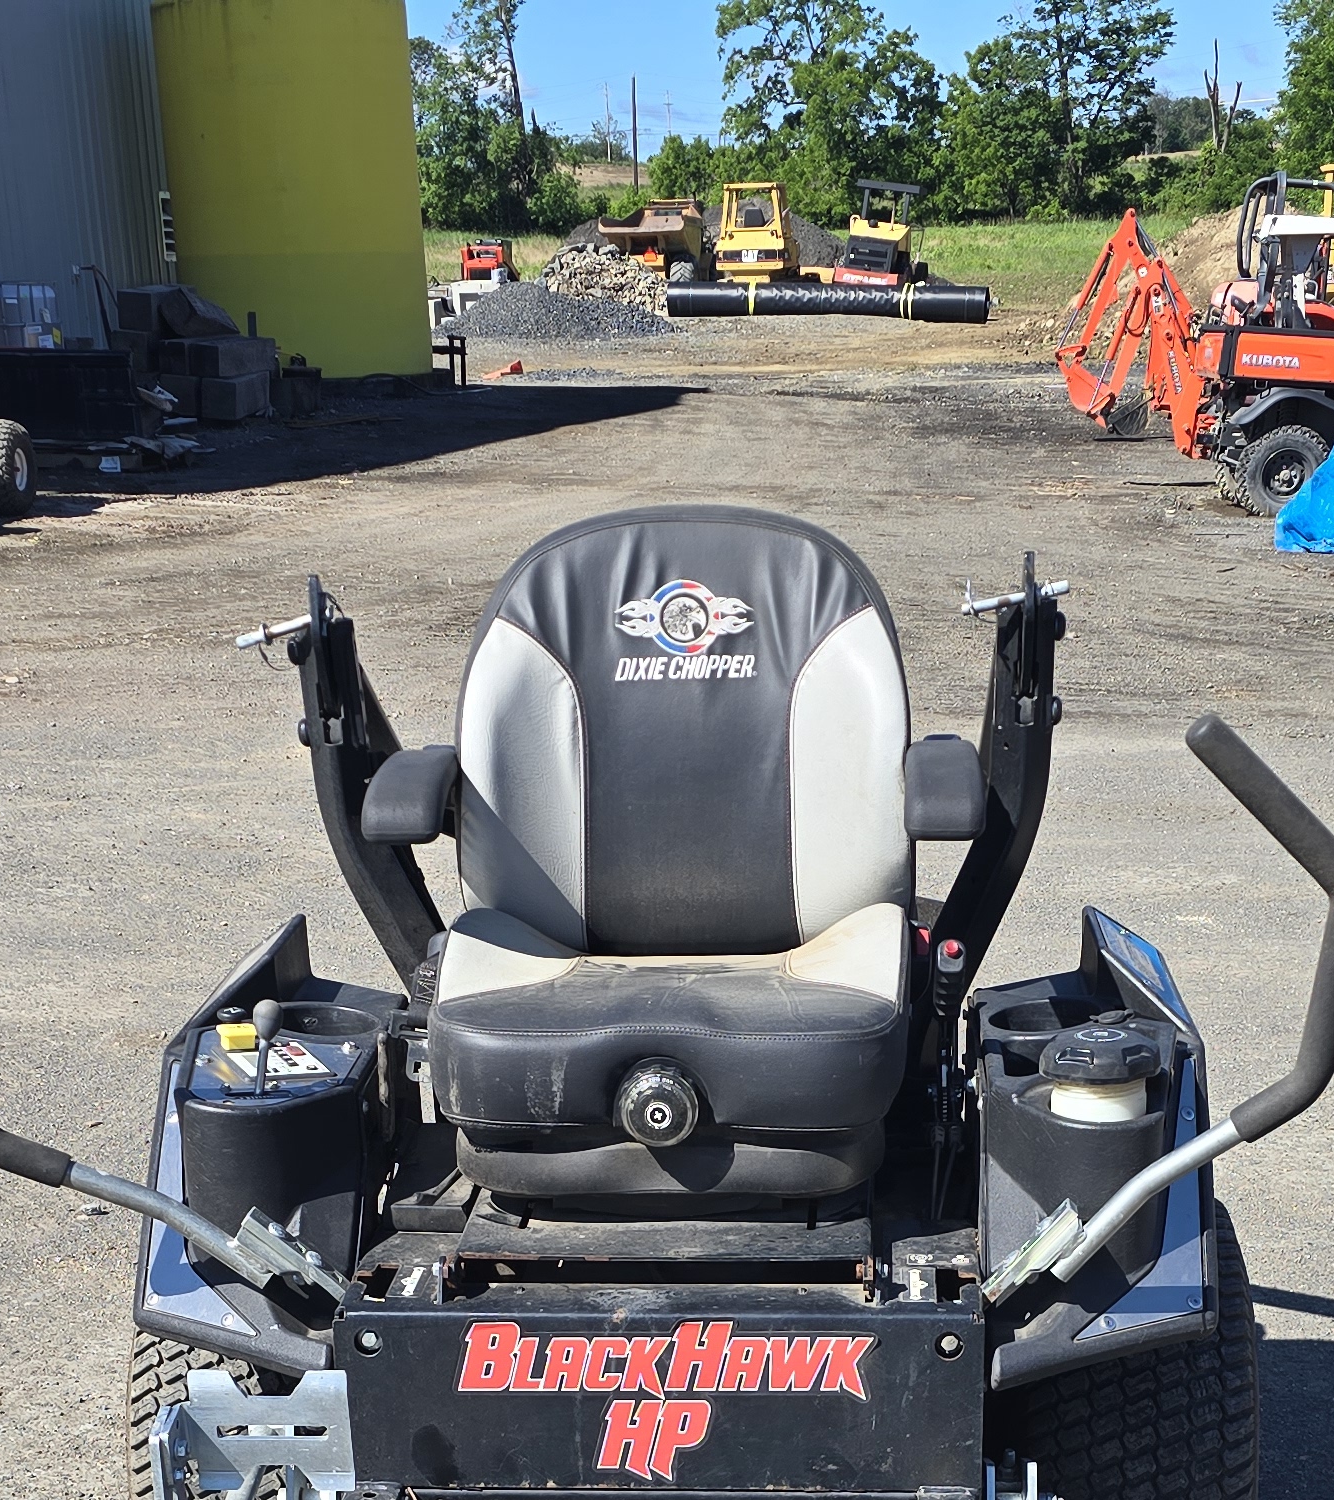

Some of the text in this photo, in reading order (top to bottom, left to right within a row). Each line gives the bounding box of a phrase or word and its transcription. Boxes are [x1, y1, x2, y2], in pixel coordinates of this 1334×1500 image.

[1167, 350, 1183, 394] KUBOTA
[1241, 353, 1300, 369] KUBOTA
[614, 654, 756, 682] DIXIE CHOPPER
[596, 1399, 712, 1482] HP
